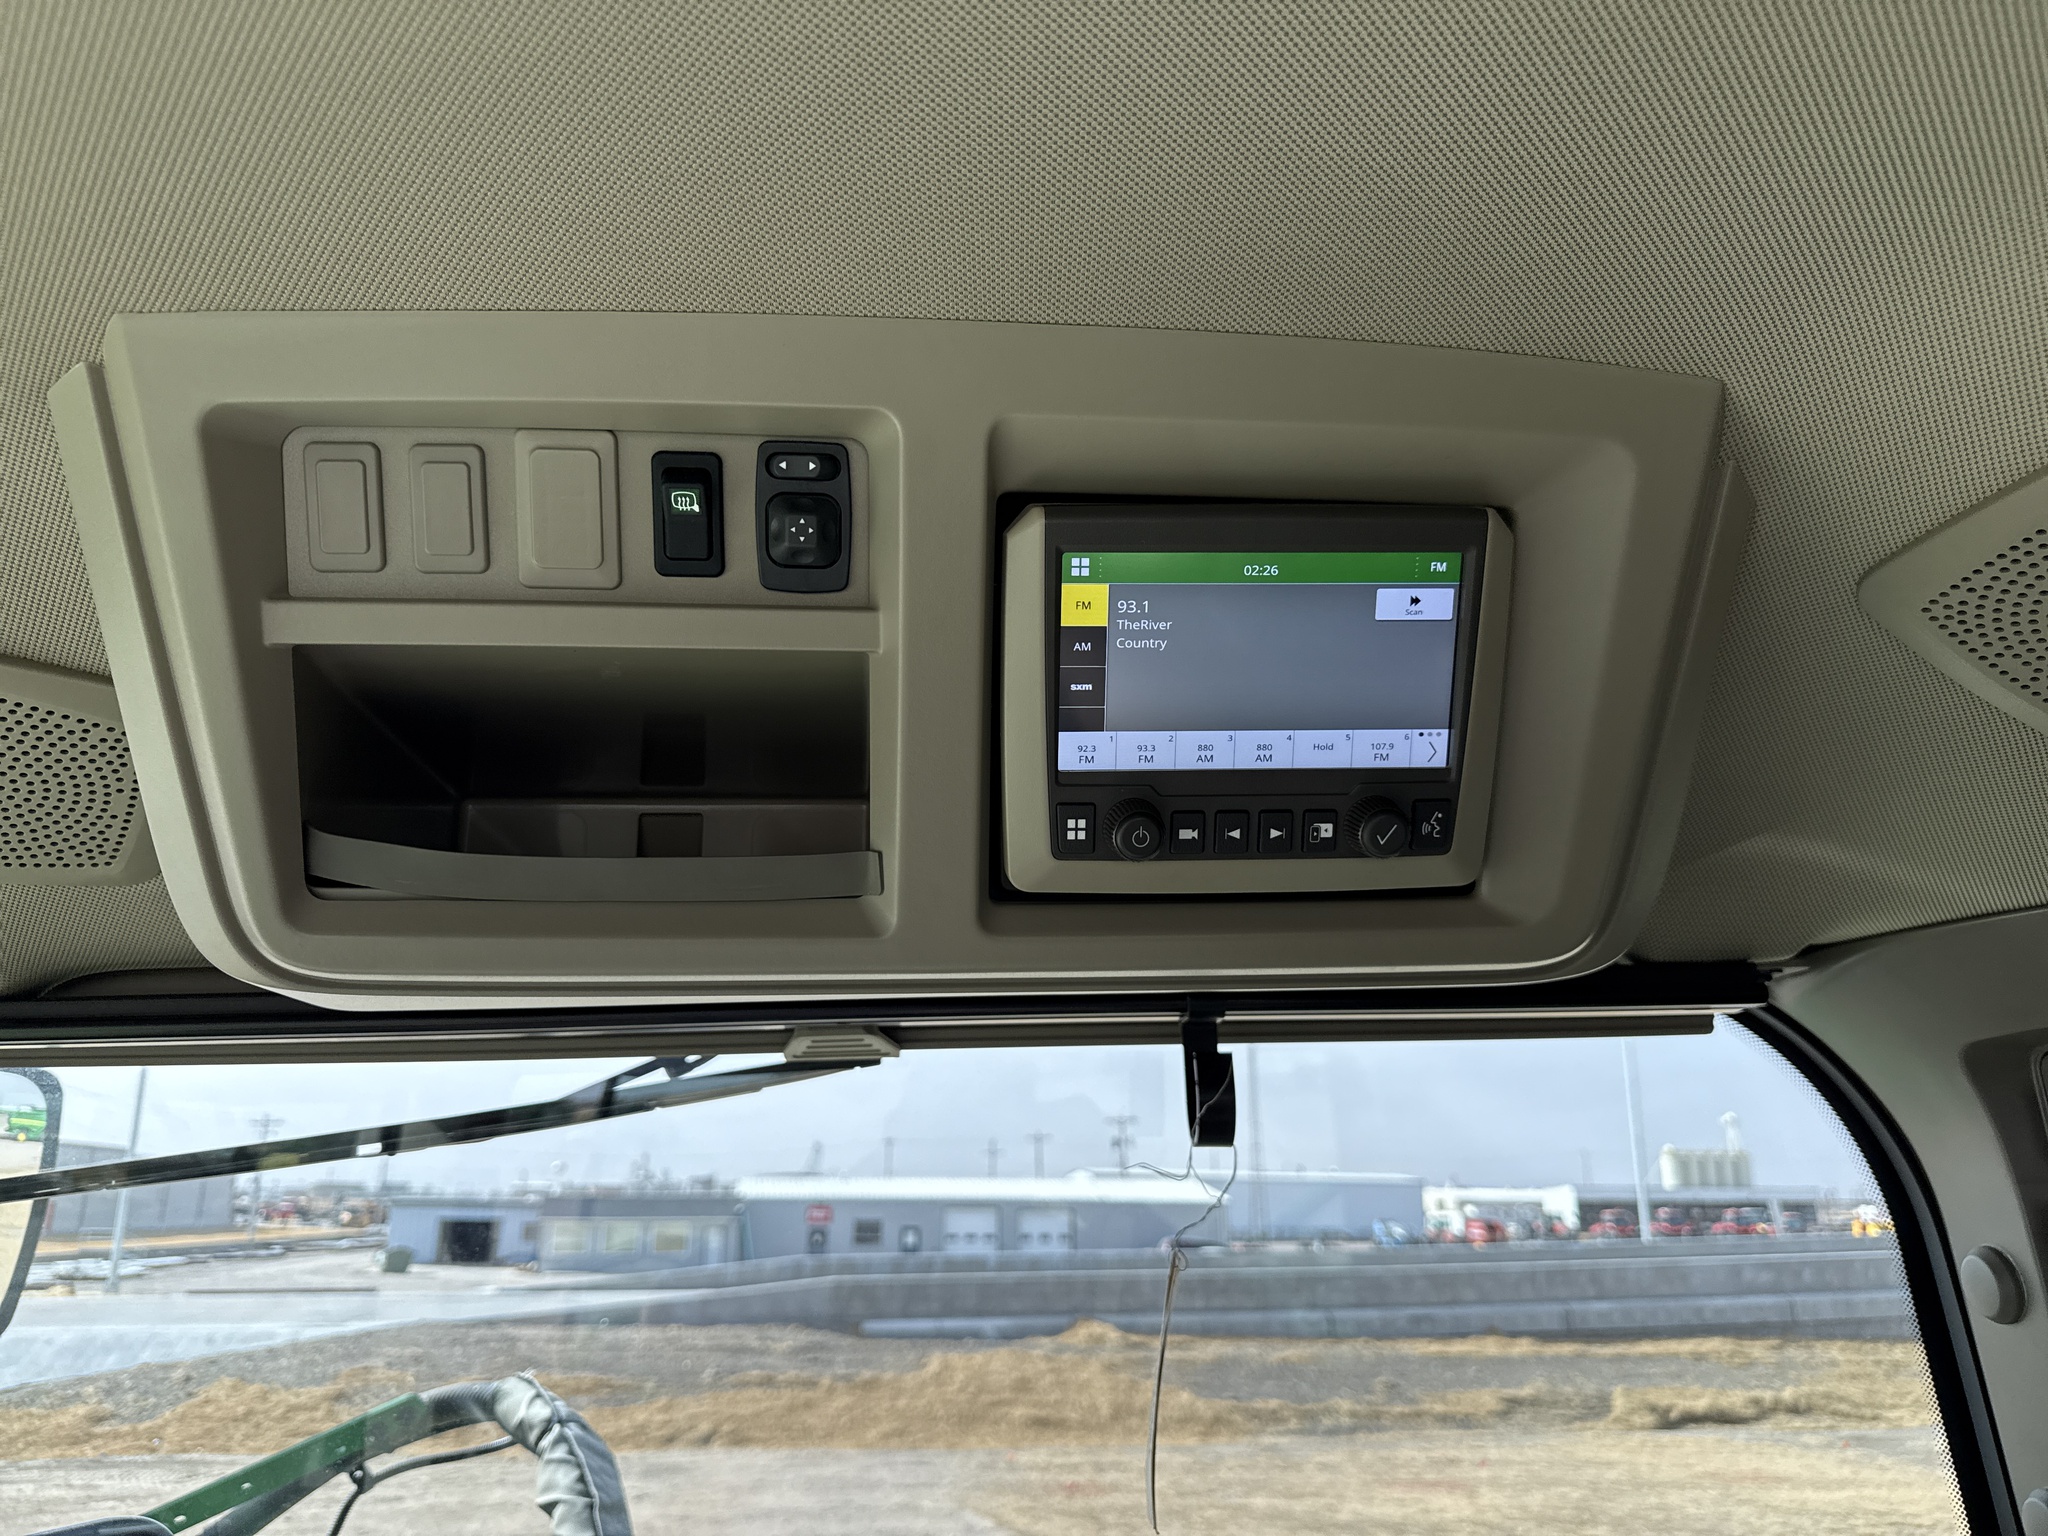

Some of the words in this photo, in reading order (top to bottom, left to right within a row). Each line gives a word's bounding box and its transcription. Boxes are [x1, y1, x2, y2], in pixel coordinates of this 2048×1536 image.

[1243, 564, 1279, 577] 02:26
[1430, 561, 1447, 573] FM
[1075, 600, 1092, 610] FM
[1117, 599, 1149, 614] 93.1
[1404, 607, 1424, 616] Scan
[1116, 619, 1173, 630] TheRiver
[1073, 642, 1092, 652] AM
[1116, 637, 1168, 651] Country
[1070, 683, 1093, 691] sxm
[1109, 735, 1114, 743] 1
[1168, 735, 1174, 743] 2
[1227, 734, 1233, 742] 3
[1345, 733, 1351, 741] 5
[1404, 733, 1410, 741] 6
[1077, 745, 1097, 753] 92.3
[1136, 744, 1156, 752] 93.3
[1197, 744, 1214, 752] 880
[1256, 743, 1273, 751] 880
[1312, 743, 1334, 751] Hold
[1370, 742, 1395, 751] 107.9
[1078, 755, 1095, 764] FM
[1138, 754, 1154, 763] FM
[1195, 754, 1214, 763] AM
[1254, 753, 1273, 763] AM
[1373, 753, 1390, 762] FM
